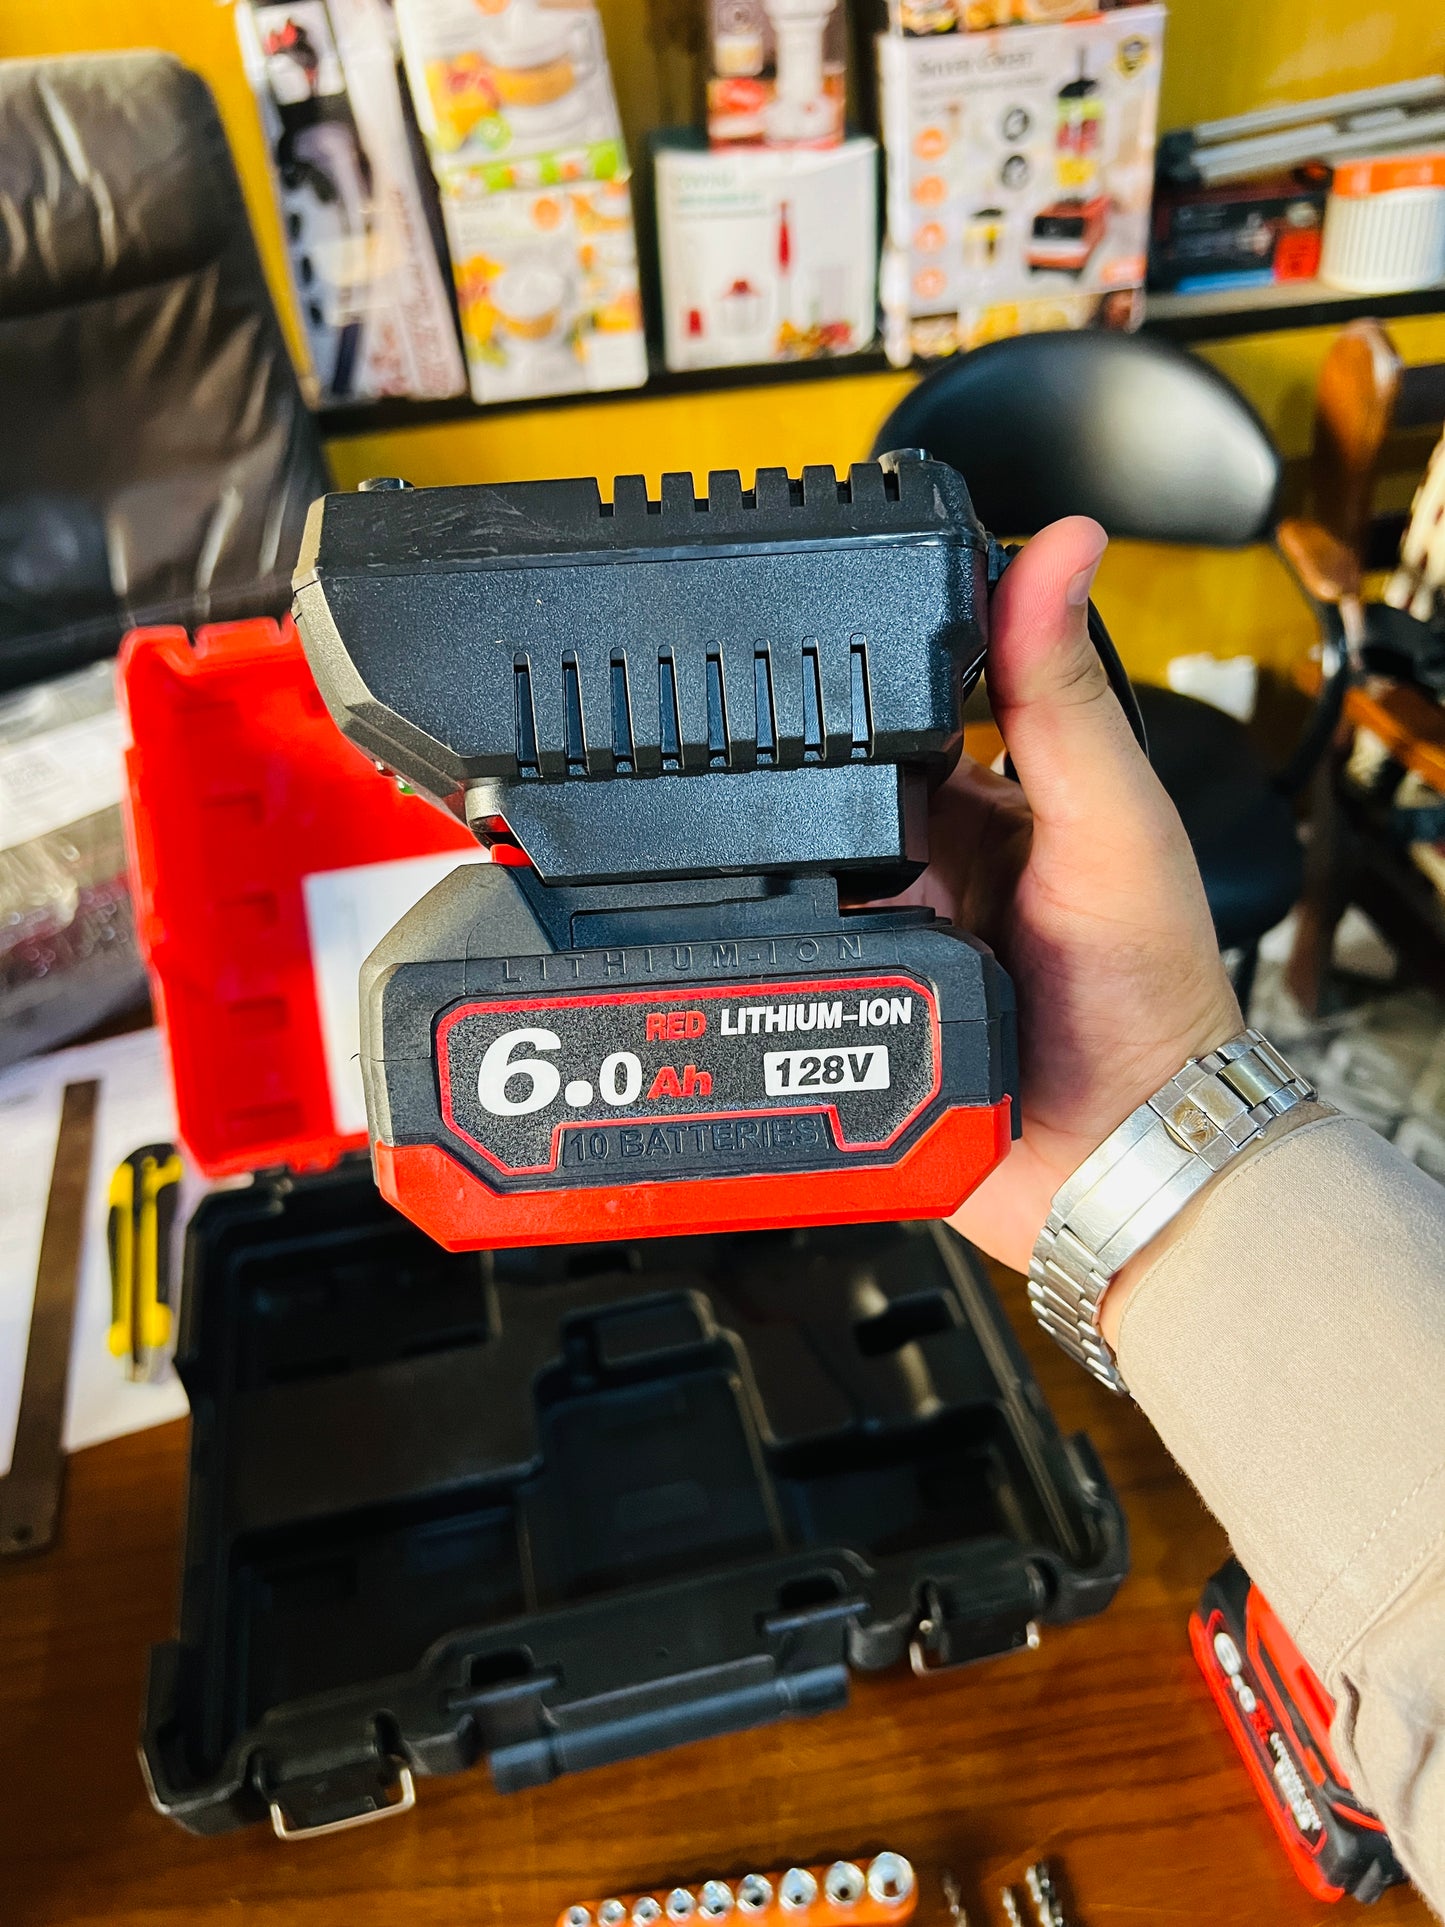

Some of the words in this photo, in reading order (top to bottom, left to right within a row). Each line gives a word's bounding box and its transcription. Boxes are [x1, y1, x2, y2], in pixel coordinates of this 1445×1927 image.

[503, 934, 863, 983] LITHIUM-ION
[645, 1010, 707, 1041] RED
[720, 996, 913, 1036] LITHIUM-ION
[775, 1052, 875, 1087] 128V
[570, 1131, 608, 1161] 10
[620, 1117, 819, 1158] BATTERIES
